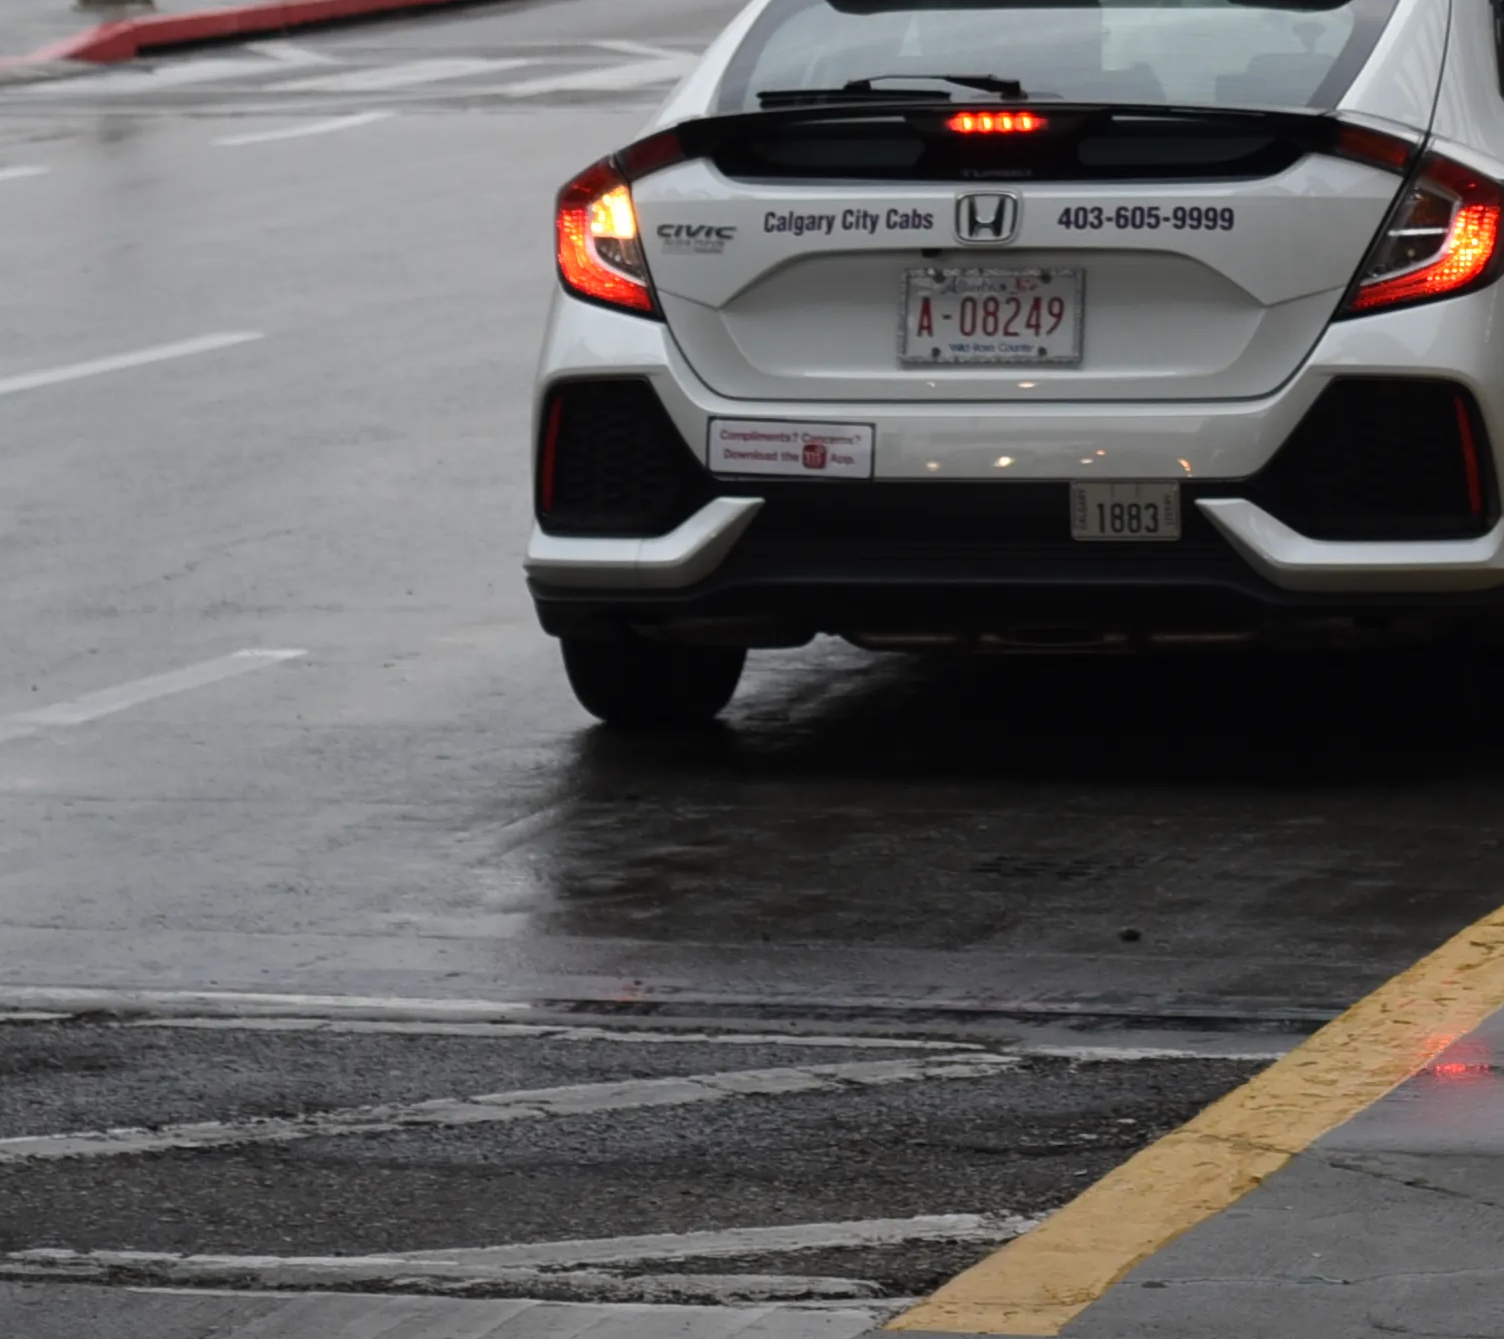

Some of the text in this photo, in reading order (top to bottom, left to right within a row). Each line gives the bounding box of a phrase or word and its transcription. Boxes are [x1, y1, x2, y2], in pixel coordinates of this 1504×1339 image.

[764, 209, 933, 235] Calgary City Cabs
[1057, 206, 1234, 231] 403-605-9999
[657, 224, 737, 240] CIVIC
[916, 295, 1066, 338] A-08249
[720, 429, 799, 443] Compliments?
[723, 448, 778, 461] Download
[781, 450, 799, 461] the
[1096, 502, 1160, 534] 1883
